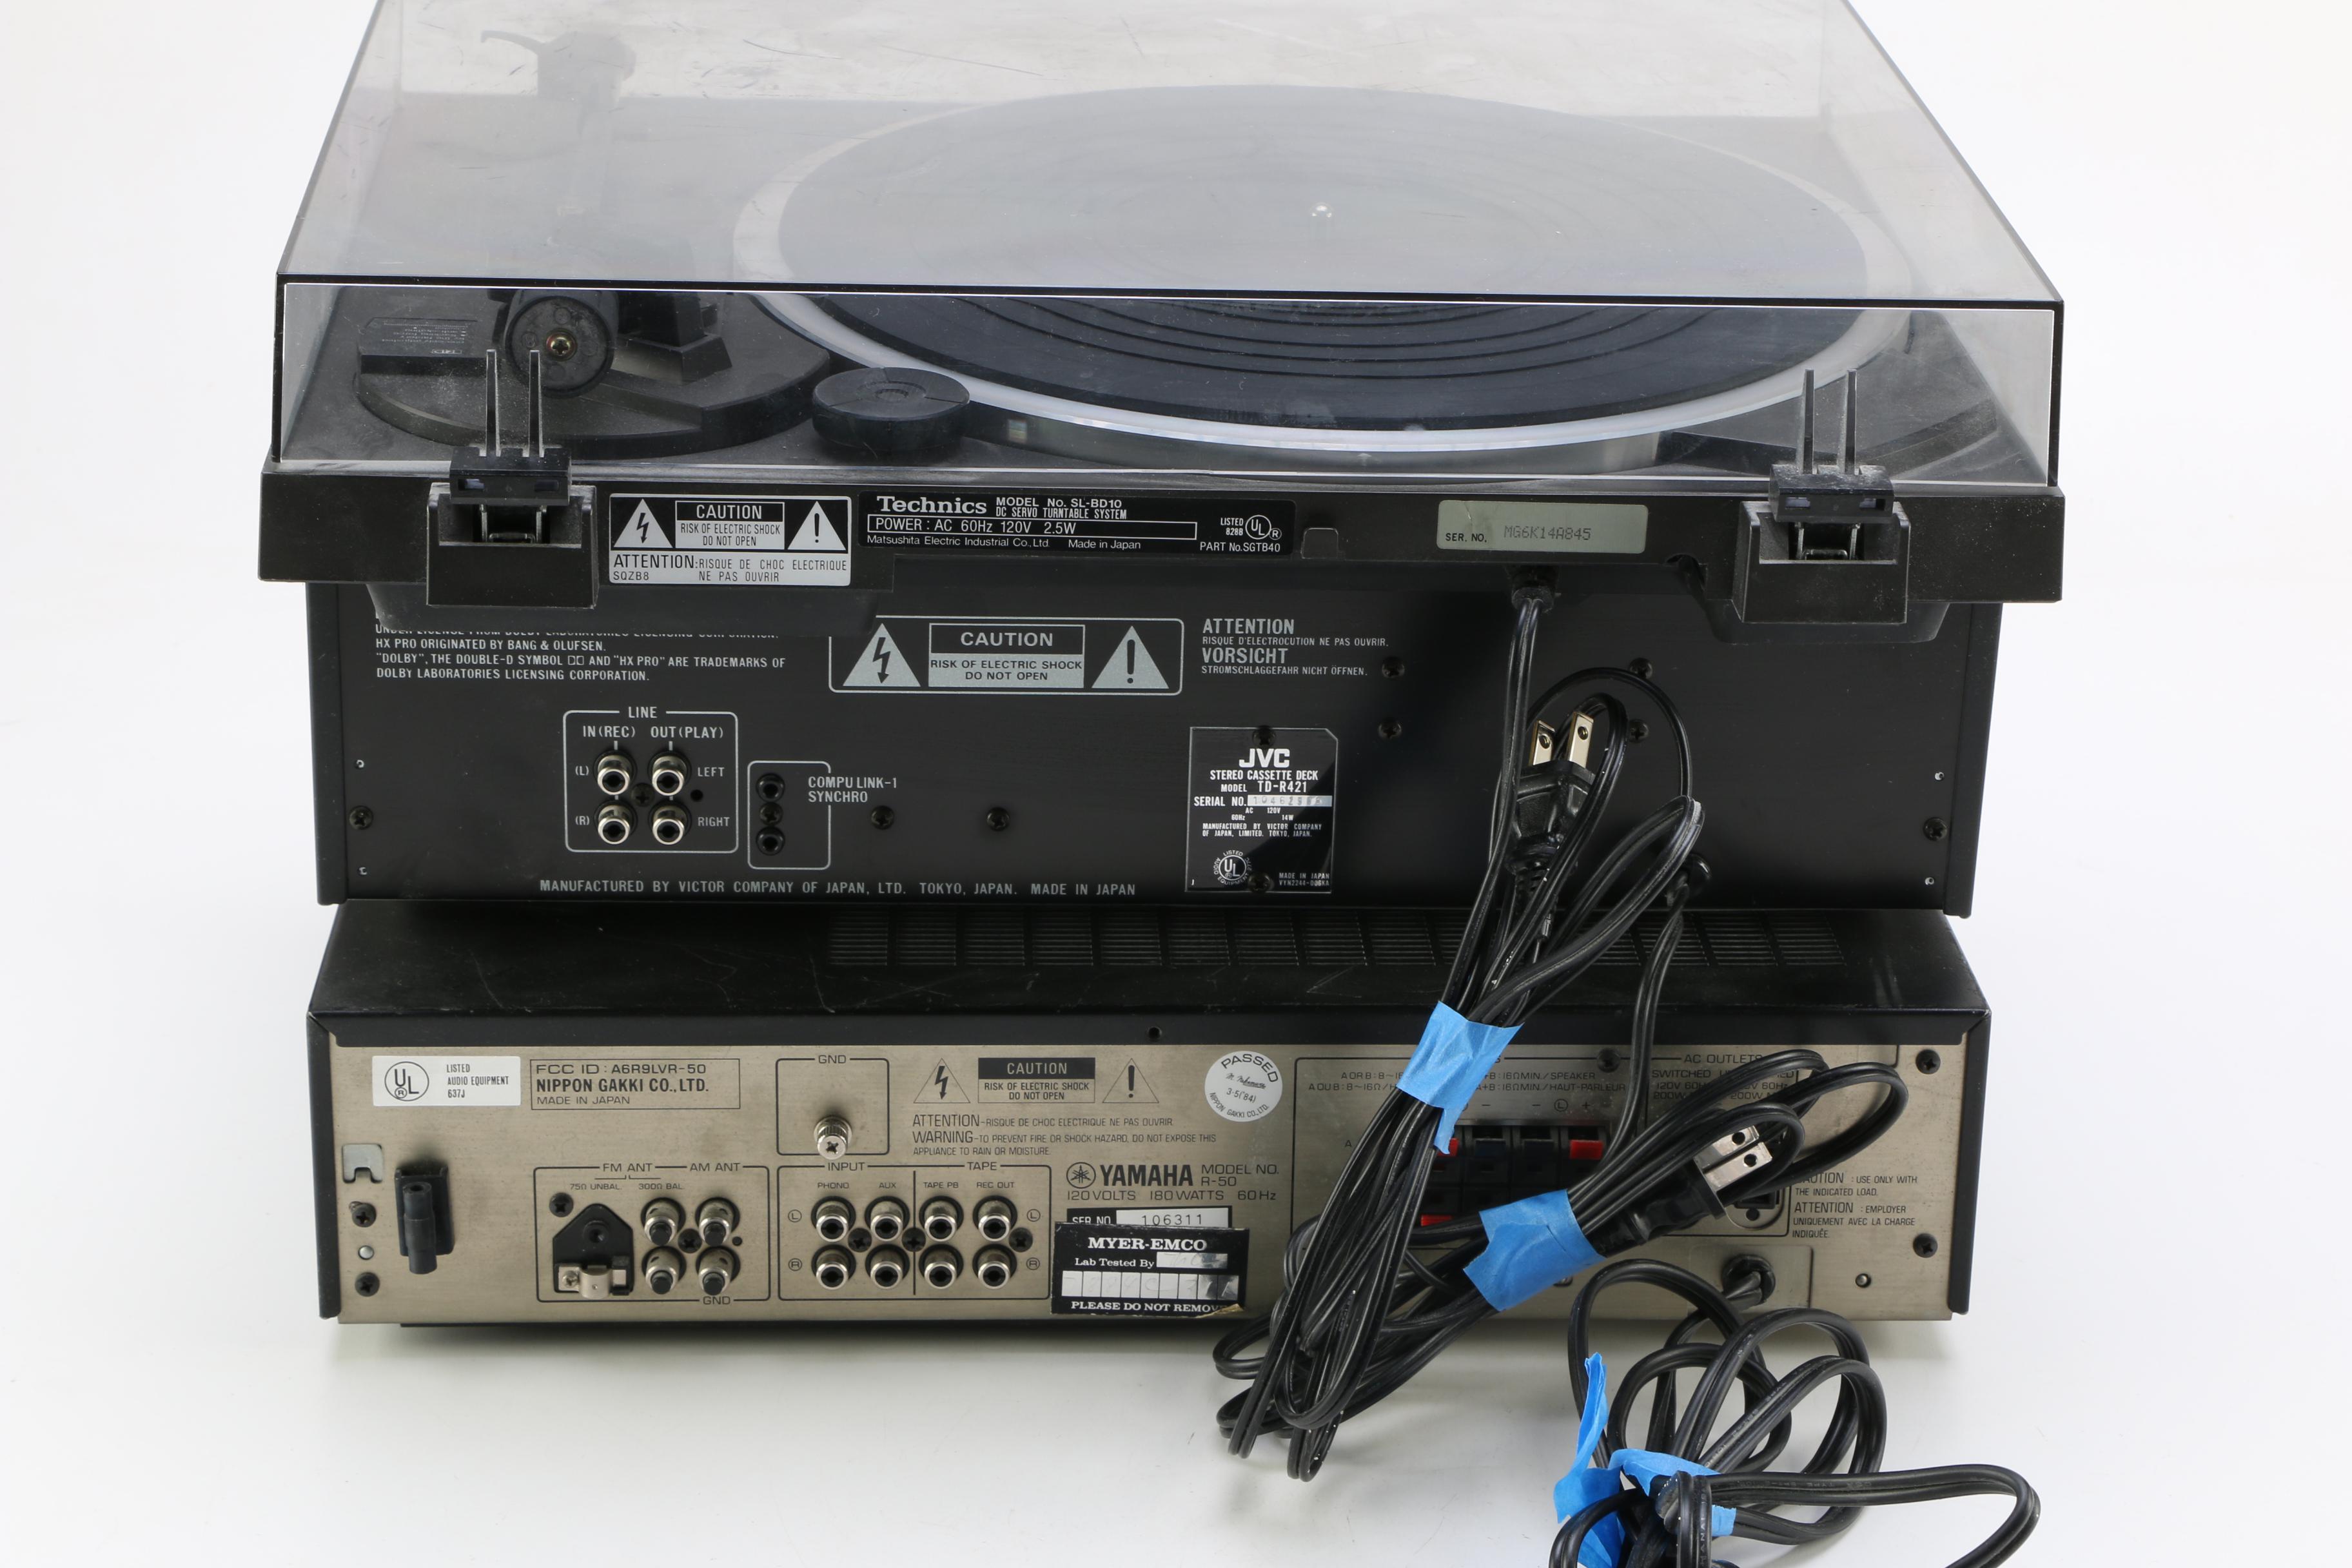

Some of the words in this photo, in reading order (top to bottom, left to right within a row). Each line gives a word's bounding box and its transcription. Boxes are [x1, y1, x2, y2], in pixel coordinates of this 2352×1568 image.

[877, 496, 986, 514] Technics
[996, 497, 1039, 507] MODEL
[1071, 499, 1122, 507] SL-BD10
[696, 505, 762, 519] CAUTION
[996, 507, 1006, 516] DC
[1012, 507, 1037, 517] SERVO
[1043, 507, 1088, 518] TURNTABLE
[1094, 509, 1126, 520] SYSTEM
[935, 519, 952, 531] AC
[961, 520, 992, 533] 60Hz
[1001, 521, 1031, 533] 120V
[1044, 522, 1076, 534] 2.5W
[1220, 518, 1243, 526] LISTED
[681, 523, 698, 534] RISK
[701, 524, 710, 534] OF
[714, 524, 751, 534] ELECTRIC
[754, 525, 780, 534] SHOCK
[703, 536, 713, 546] DO
[716, 536, 732, 546] NOT
[736, 536, 756, 546] OPEN
[868, 535, 919, 545] Matsushita
[925, 536, 961, 545] Electric
[965, 537, 1008, 546] Industrial
[1069, 539, 1095, 549] Made
[1111, 540, 1141, 551] Japan
[1200, 542, 1226, 551] PART
[740, 560, 750, 569] DE
[760, 560, 784, 570] CHOC
[792, 561, 847, 571] ELECTRIQUE
[700, 571, 711, 581] NE
[720, 572, 737, 582] PAS
[745, 573, 779, 582] OUVRIR
[1203, 618, 1294, 634] ATTENTION
[377, 639, 390, 649] HX
[395, 639, 416, 649] PRO
[421, 639, 485, 649] ORIGINATED
[490, 640, 503, 650] BY
[508, 640, 536, 650] BANG
[540, 641, 549, 650] &
[961, 632, 1053, 647] CAUTION
[1203, 637, 1233, 645] RISQUE
[431, 654, 451, 663] THE
[456, 655, 513, 665] DOUBLE-D
[518, 655, 562, 665] SYMBOL
[589, 656, 610, 665] AND
[668, 657, 689, 667] ARE
[694, 657, 767, 667] TRADEMARKS
[772, 658, 785, 667] OF
[1202, 648, 1288, 663] VORSICHT
[931, 660, 957, 669] RISK
[961, 660, 977, 669] OF
[981, 660, 1037, 669] ELECTRIC
[1042, 661, 1082, 670] SHOCK
[377, 668, 411, 678] DOLBY
[418, 669, 500, 678] LABORATORIES
[505, 669, 564, 680] LICENSING
[1202, 666, 1298, 674] STROMSCHLAGGEFAHR
[1302, 667, 1328, 675] NICHT
[965, 671, 982, 680] DO
[987, 671, 1010, 680] NOT
[1017, 672, 1048, 681] OPEN
[628, 707, 656, 719] LINE
[1239, 749, 1289, 768] JVC
[698, 767, 724, 777] LEFT
[1210, 770, 1243, 780] STEREO
[1248, 770, 1291, 780] CASSETTE
[1297, 771, 1318, 780] DECK
[1257, 781, 1306, 792] TD-R421
[808, 791, 868, 803] SYNCHRO
[1194, 797, 1225, 806] SERIAL
[698, 817, 730, 827] RIGHT
[540, 880, 643, 892] MANUFACTURED
[653, 881, 669, 892] BY
[679, 881, 724, 892] VICTOR
[734, 881, 792, 893] COMPANY
[803, 882, 816, 893] OF
[1032, 883, 1066, 895] MADE
[1076, 884, 1088, 895] IN
[1097, 884, 1135, 896] JAPAN
[819, 1055, 846, 1064] GND
[447, 1064, 470, 1073] LISTED
[536, 1064, 574, 1073] FCC
[1007, 1063, 1067, 1075] CAUTION
[1221, 1054, 1278, 1082] PASSED
[447, 1077, 467, 1085] AUDIO
[471, 1076, 508, 1085] EQUIPMENT
[537, 1079, 592, 1092] NIPPON
[599, 1079, 643, 1092] GAKKI
[1062, 1082, 1089, 1090] SHOCK
[448, 1090, 465, 1098] 637J
[992, 1134, 1027, 1143] PREVENT
[1166, 1134, 1196, 1142] EXPOSE
[603, 1164, 622, 1172] FM
[690, 1163, 709, 1171] AM
[715, 1163, 740, 1171] ANT
[828, 1162, 865, 1171] INPUT
[967, 1162, 997, 1170] TAPE
[1100, 1164, 1193, 1186] YAMAHA
[1202, 1165, 1251, 1174] MODEL
[1202, 1177, 1237, 1186] R-50
[1795, 1202, 1853, 1213] ATTENTION
[1142, 1215, 1201, 1226] 106311
[1088, 1237, 1206, 1250] MYER-EMCO
[1099, 1259, 1136, 1267] Tested
[1140, 1260, 1154, 1268] By
[703, 1297, 730, 1305] GND
[1072, 1302, 1120, 1310] PLEASE
